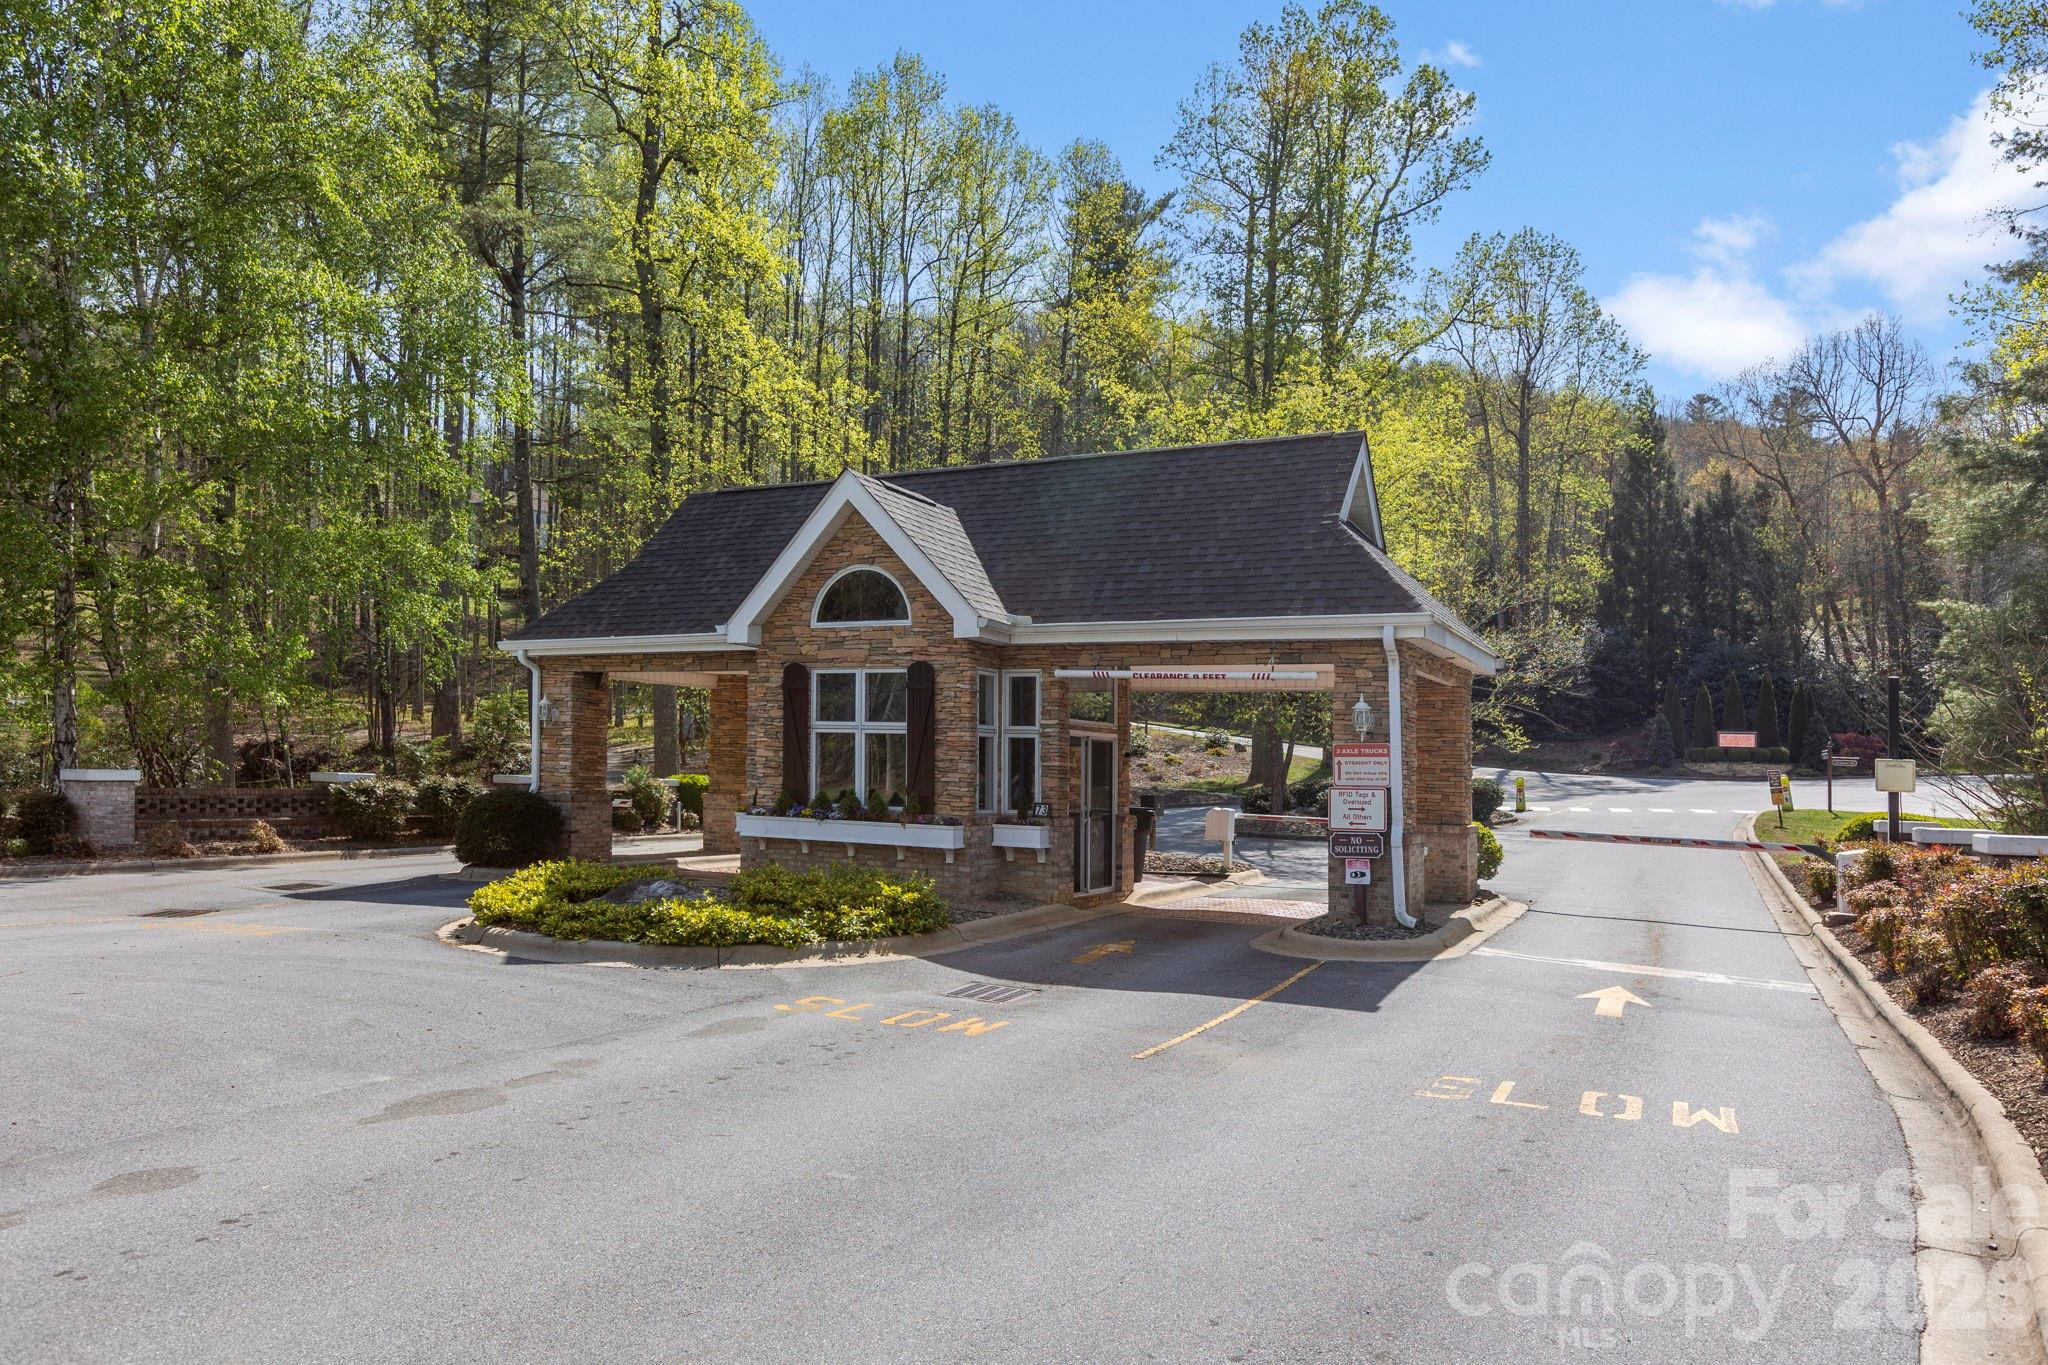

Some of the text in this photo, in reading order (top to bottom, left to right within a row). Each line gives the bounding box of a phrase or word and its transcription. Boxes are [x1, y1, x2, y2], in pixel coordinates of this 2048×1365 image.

[1132, 672, 1190, 680] CLEARANCE
[1355, 791, 1369, 799] Tags
[1036, 805, 1048, 816] 73
[1334, 845, 1379, 854] SOLICITING
[773, 995, 1012, 1037] SLOW
[1413, 1075, 1740, 1134] SLOW
